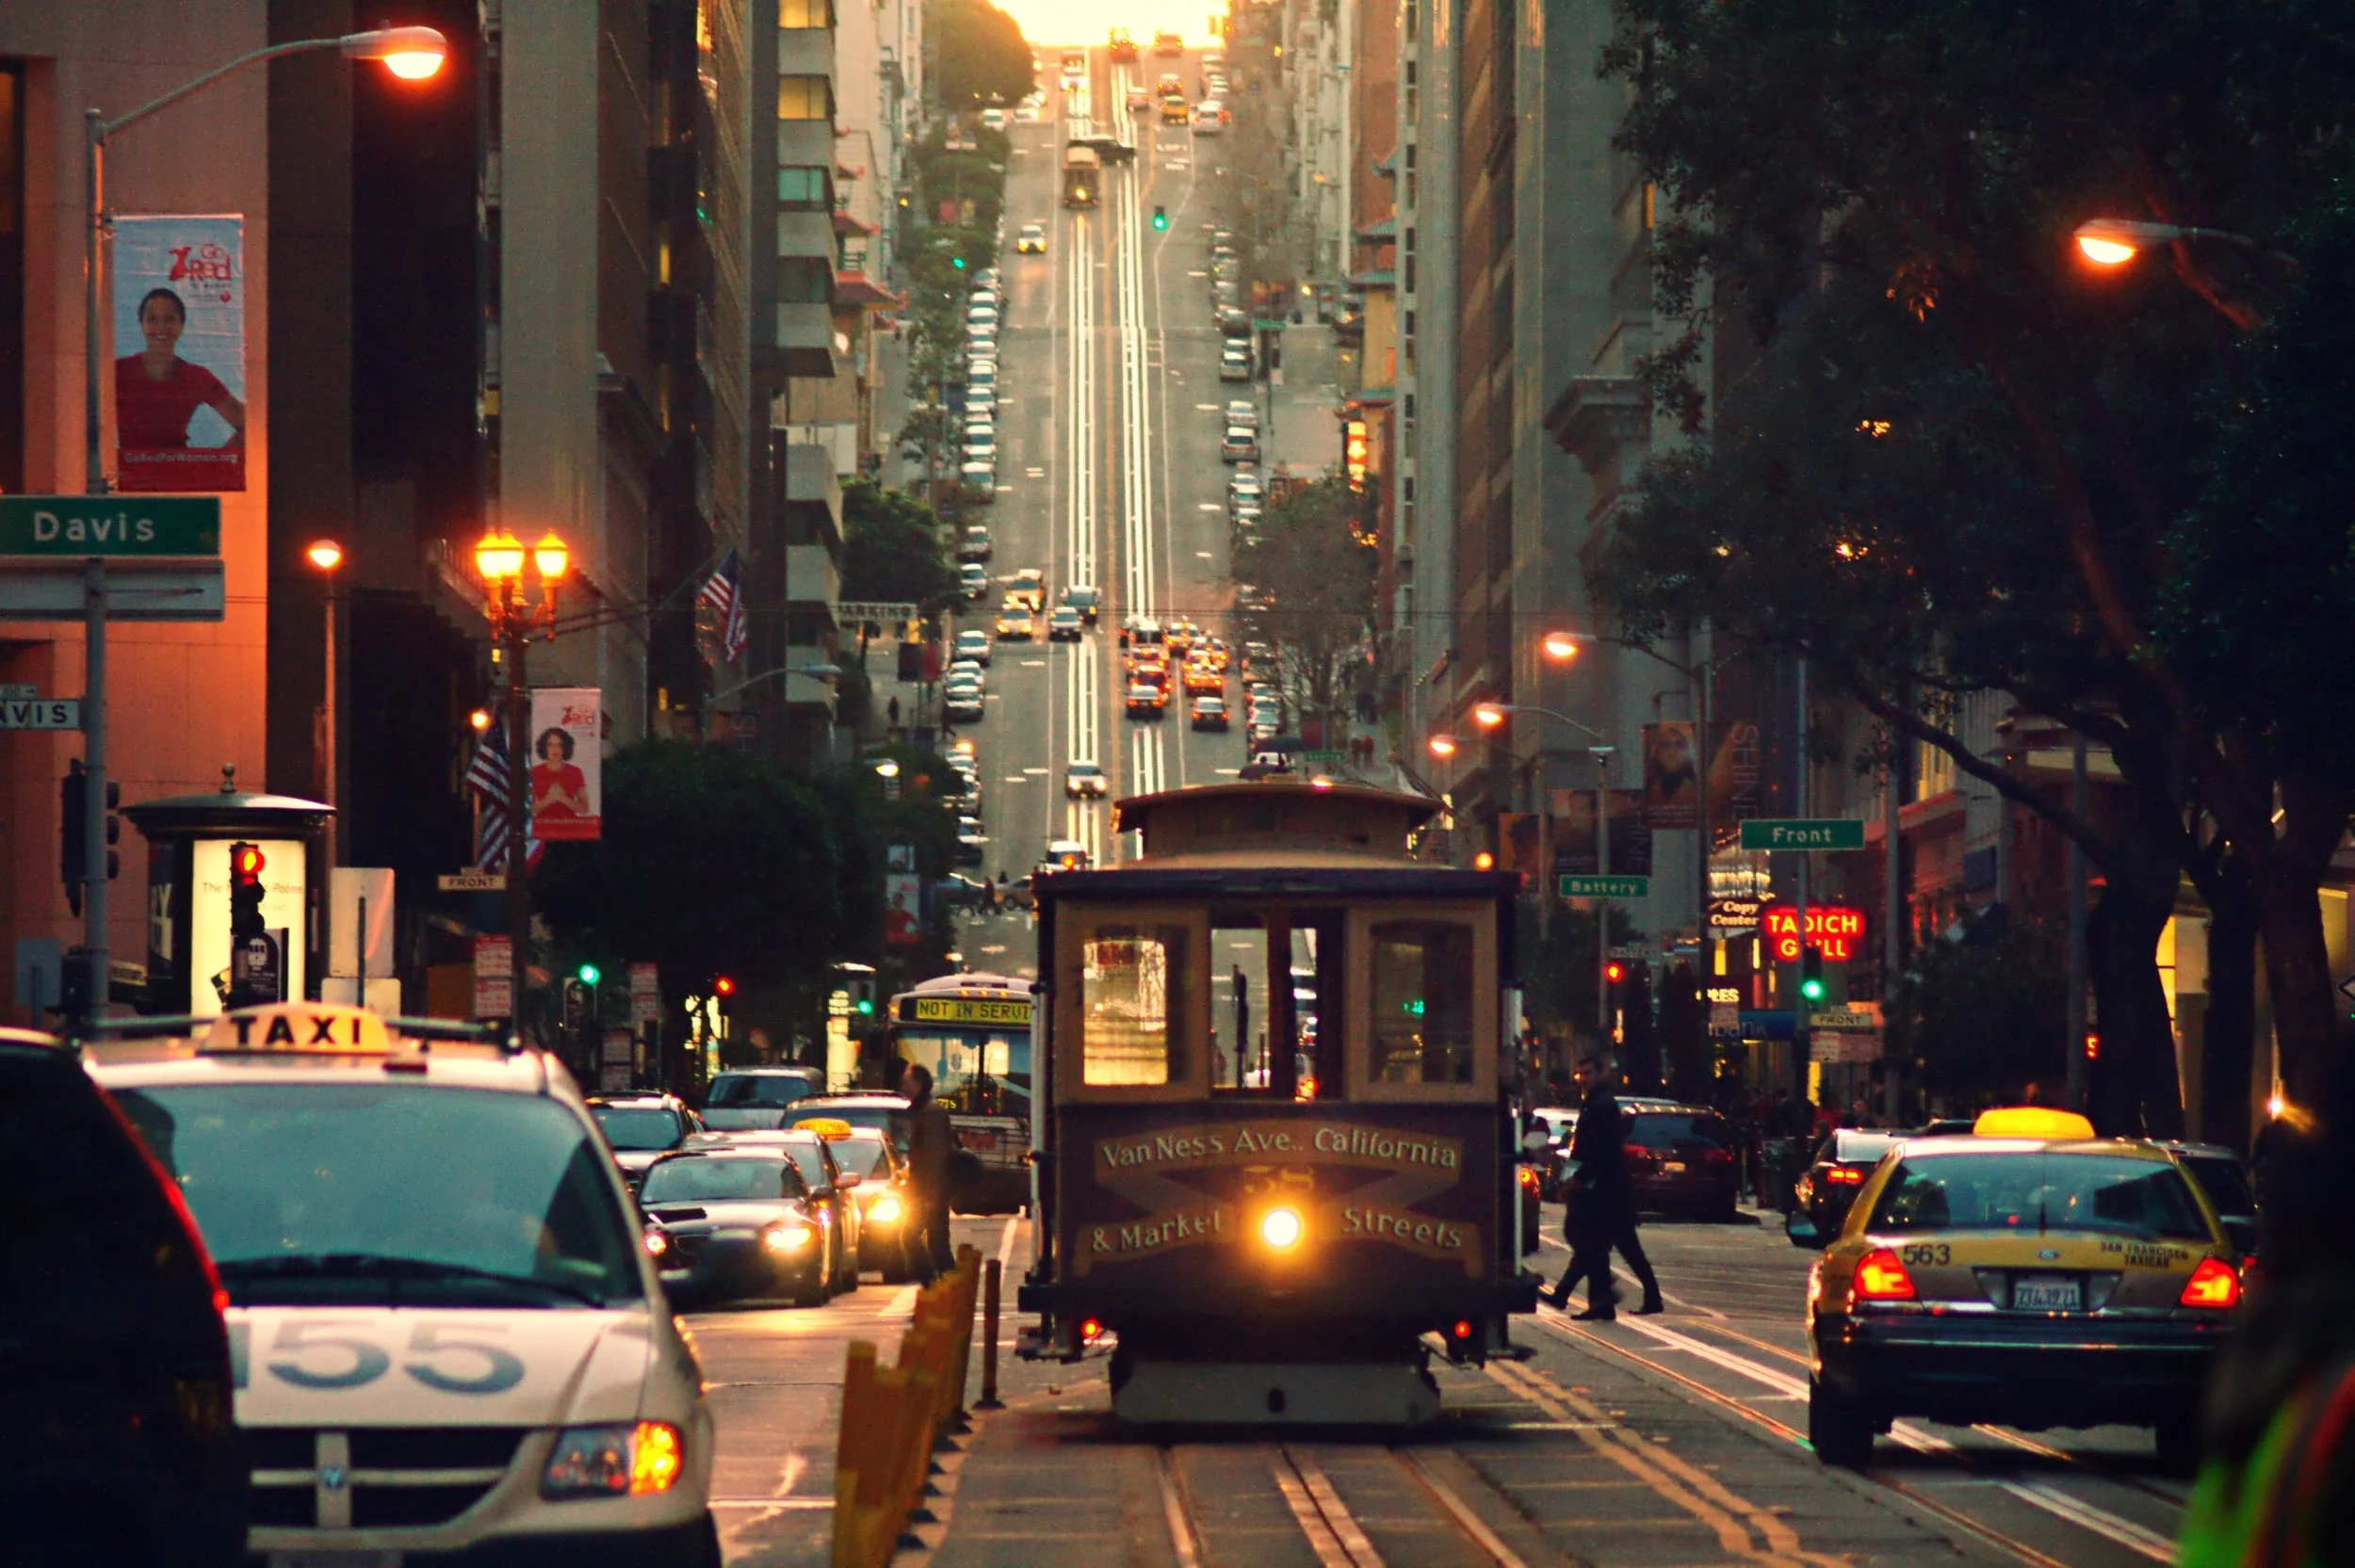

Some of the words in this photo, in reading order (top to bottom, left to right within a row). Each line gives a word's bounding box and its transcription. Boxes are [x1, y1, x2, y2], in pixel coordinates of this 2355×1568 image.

[201, 242, 225, 260] Go
[190, 254, 232, 281] Red
[34, 511, 154, 542] Davis
[1772, 827, 1832, 843] Front
[448, 878, 495, 887] FRONT
[1571, 881, 1637, 894] Battery
[1723, 900, 1759, 914] Copy
[1711, 914, 1760, 926] Center
[918, 1001, 950, 1017] NOT
[956, 1003, 973, 1018] IN
[1819, 1014, 1863, 1025] FRONT
[230, 1015, 362, 1044] TAXI
[1103, 1141, 1152, 1169] Van
[1154, 1135, 1225, 1161] Ness
[1314, 1128, 1457, 1169] California
[1091, 1227, 1113, 1253] &
[1119, 1209, 1222, 1251] Market
[1341, 1206, 1463, 1248] Streets
[1903, 1243, 1951, 1266] 563
[2101, 1241, 2122, 1253] SAN
[2126, 1243, 2189, 1260] FRANCISCO
[2125, 1253, 2170, 1269] TAXICAB
